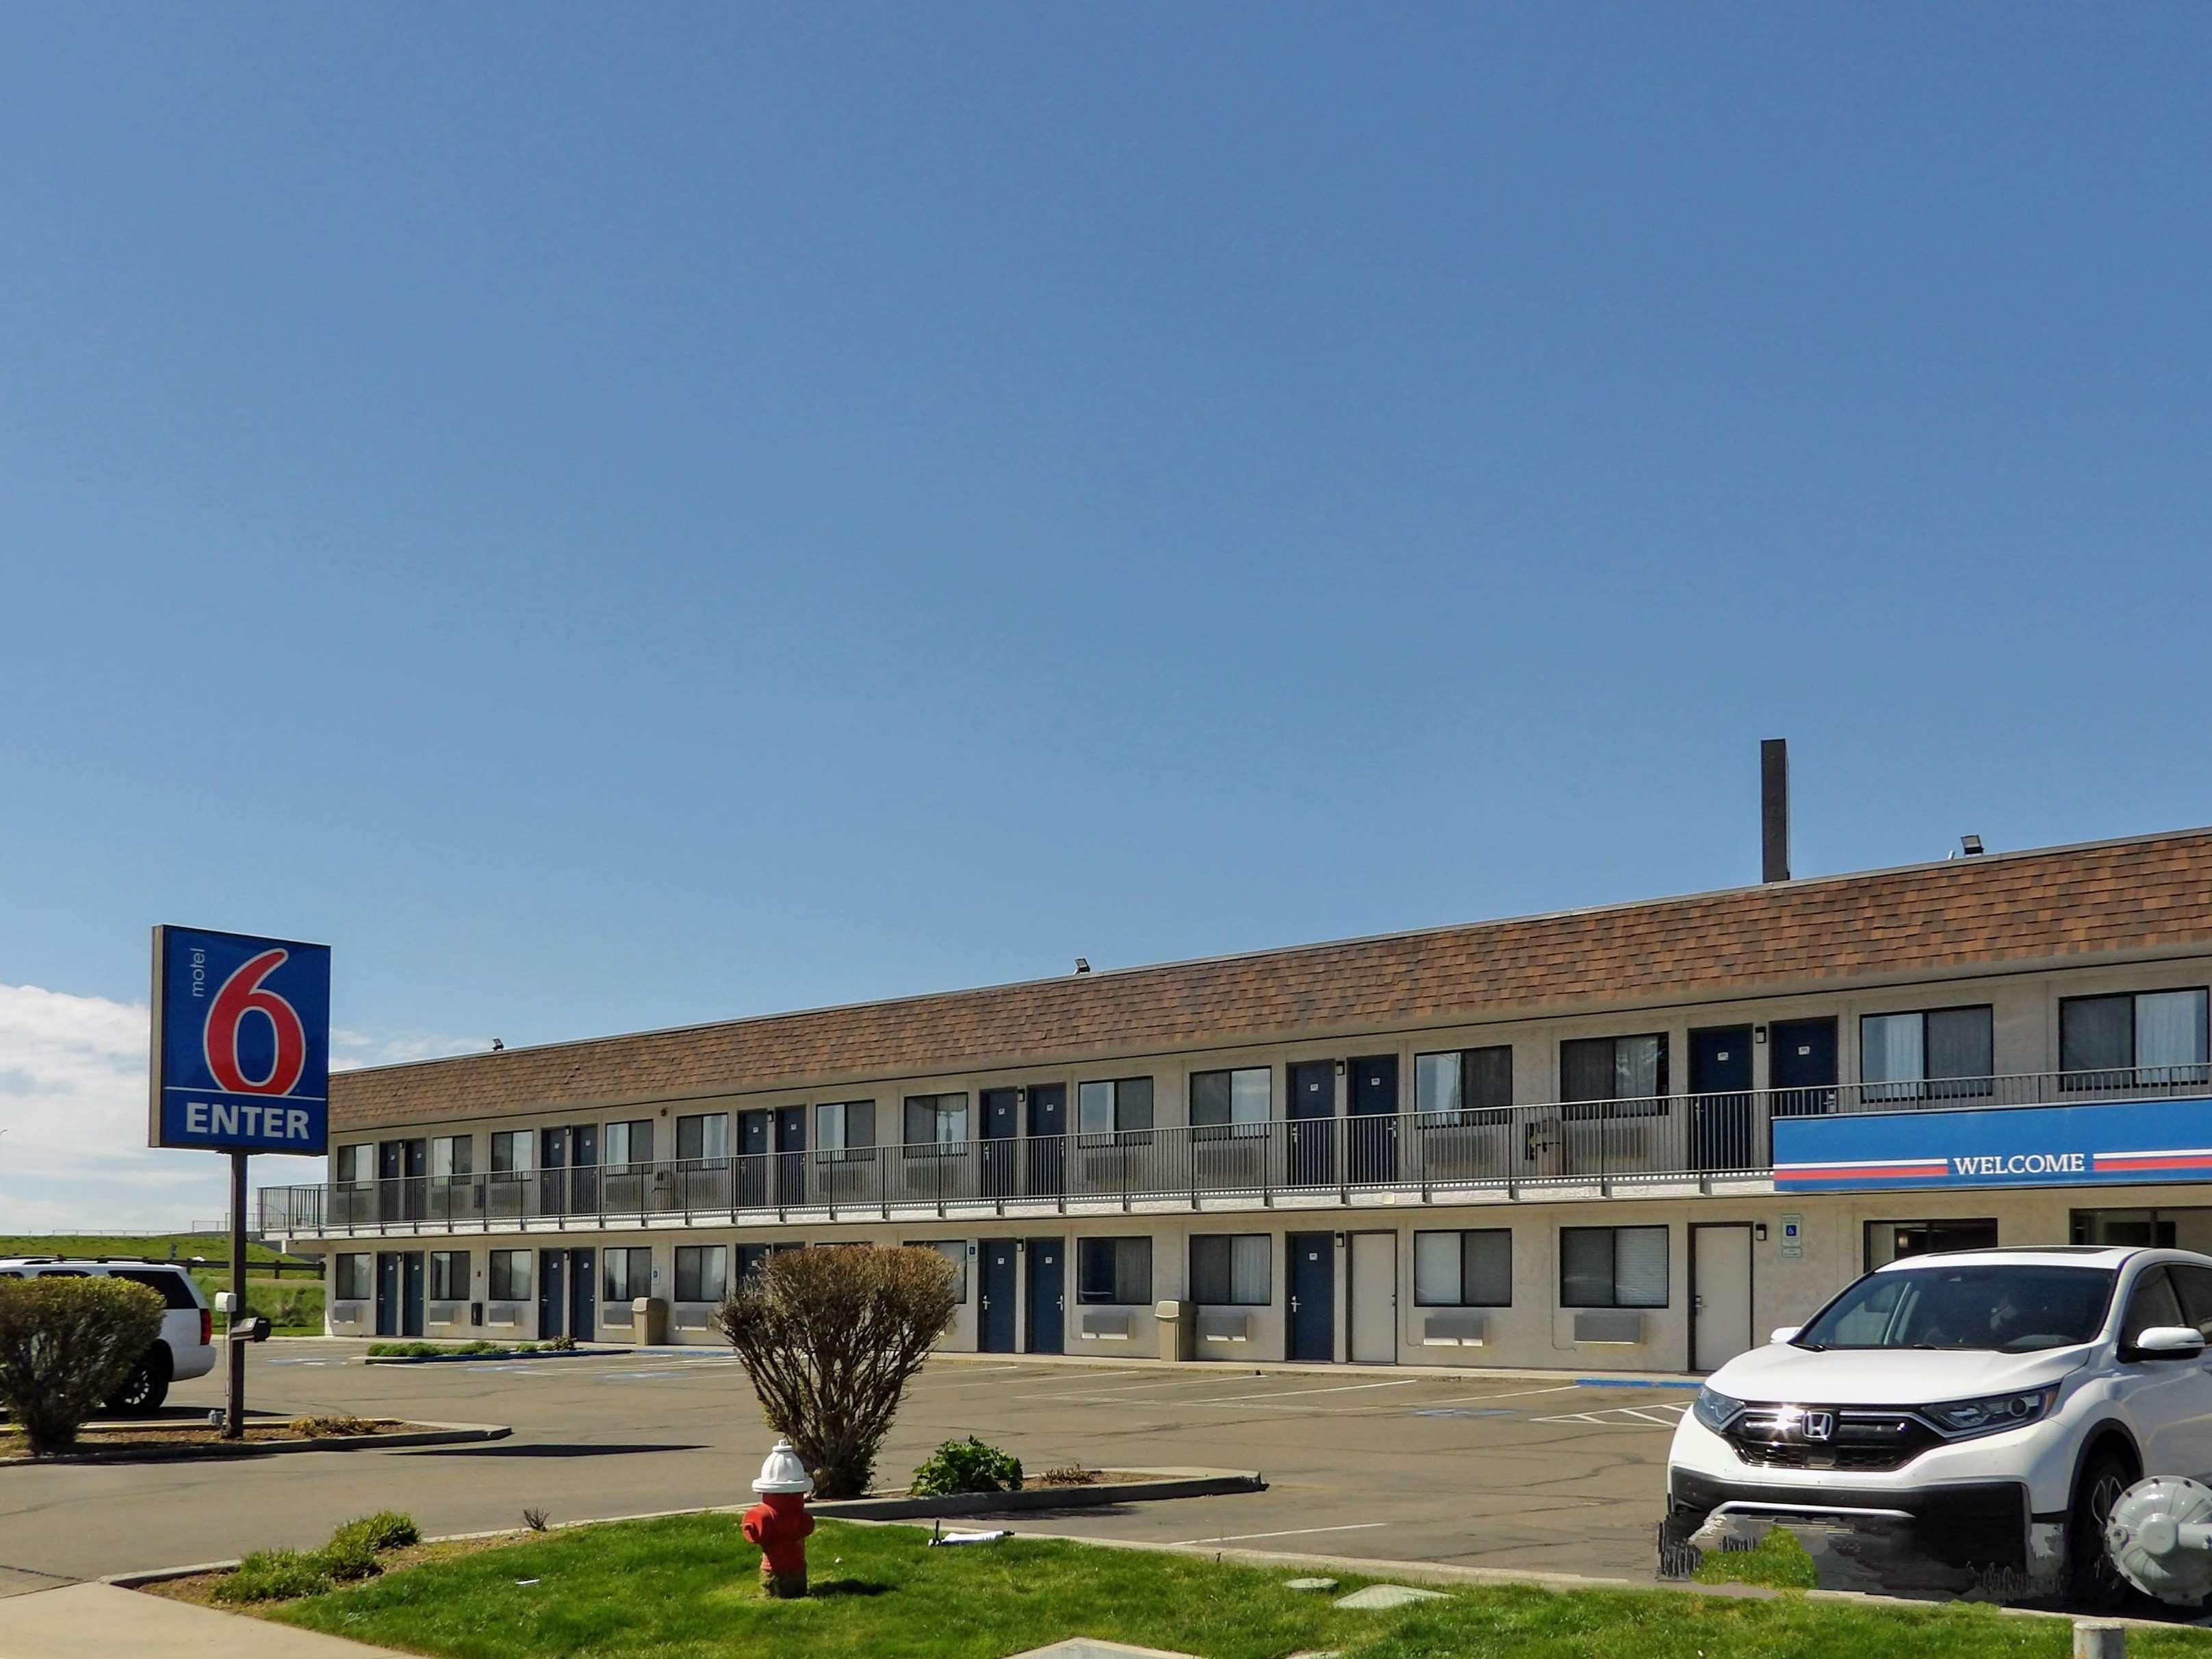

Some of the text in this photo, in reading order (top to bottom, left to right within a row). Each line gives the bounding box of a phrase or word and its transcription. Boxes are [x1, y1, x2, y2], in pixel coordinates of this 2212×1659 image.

[190, 947, 306, 1096] motel 6
[186, 1102, 309, 1140] ENTER
[1953, 1153, 2085, 1175] WELCOME
